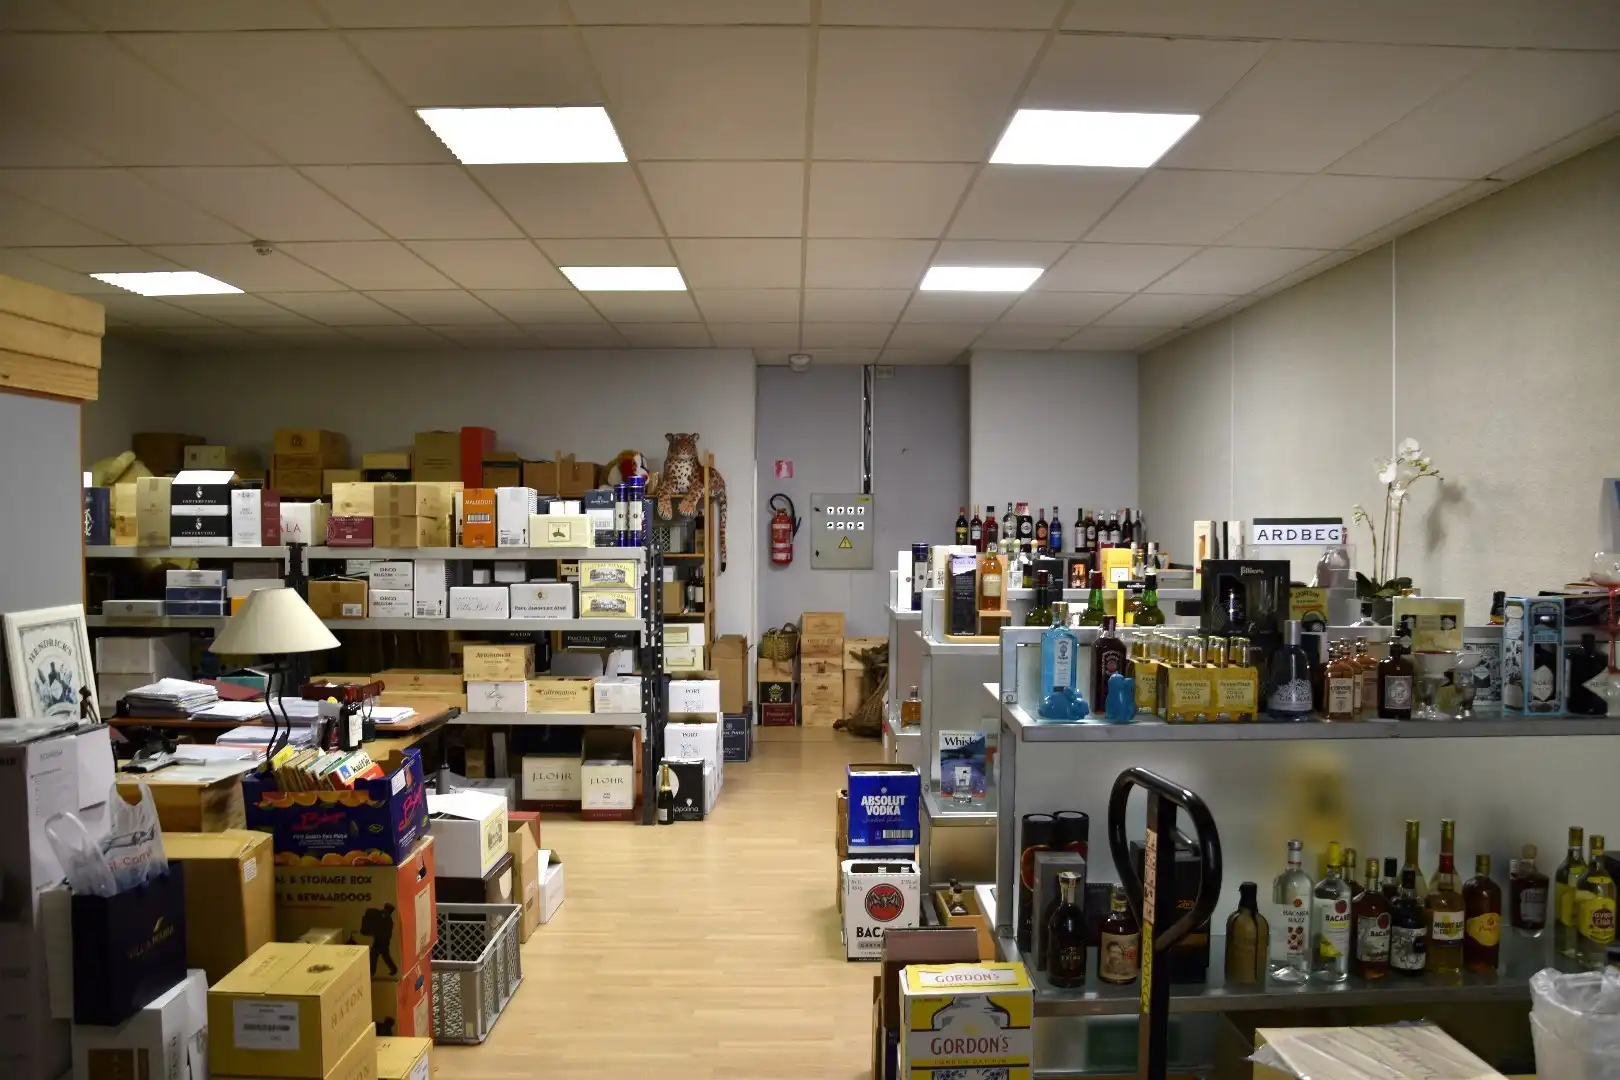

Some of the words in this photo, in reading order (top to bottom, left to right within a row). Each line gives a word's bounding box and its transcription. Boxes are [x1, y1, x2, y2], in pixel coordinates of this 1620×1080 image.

[1257, 528, 1339, 541] ARDBEG
[861, 795, 906, 806] ABSOLUT
[866, 805, 901, 816] VODKA
[350, 875, 372, 885] BOX
[935, 973, 999, 983] GORDON'S
[931, 1036, 1009, 1055] GORDON'S
